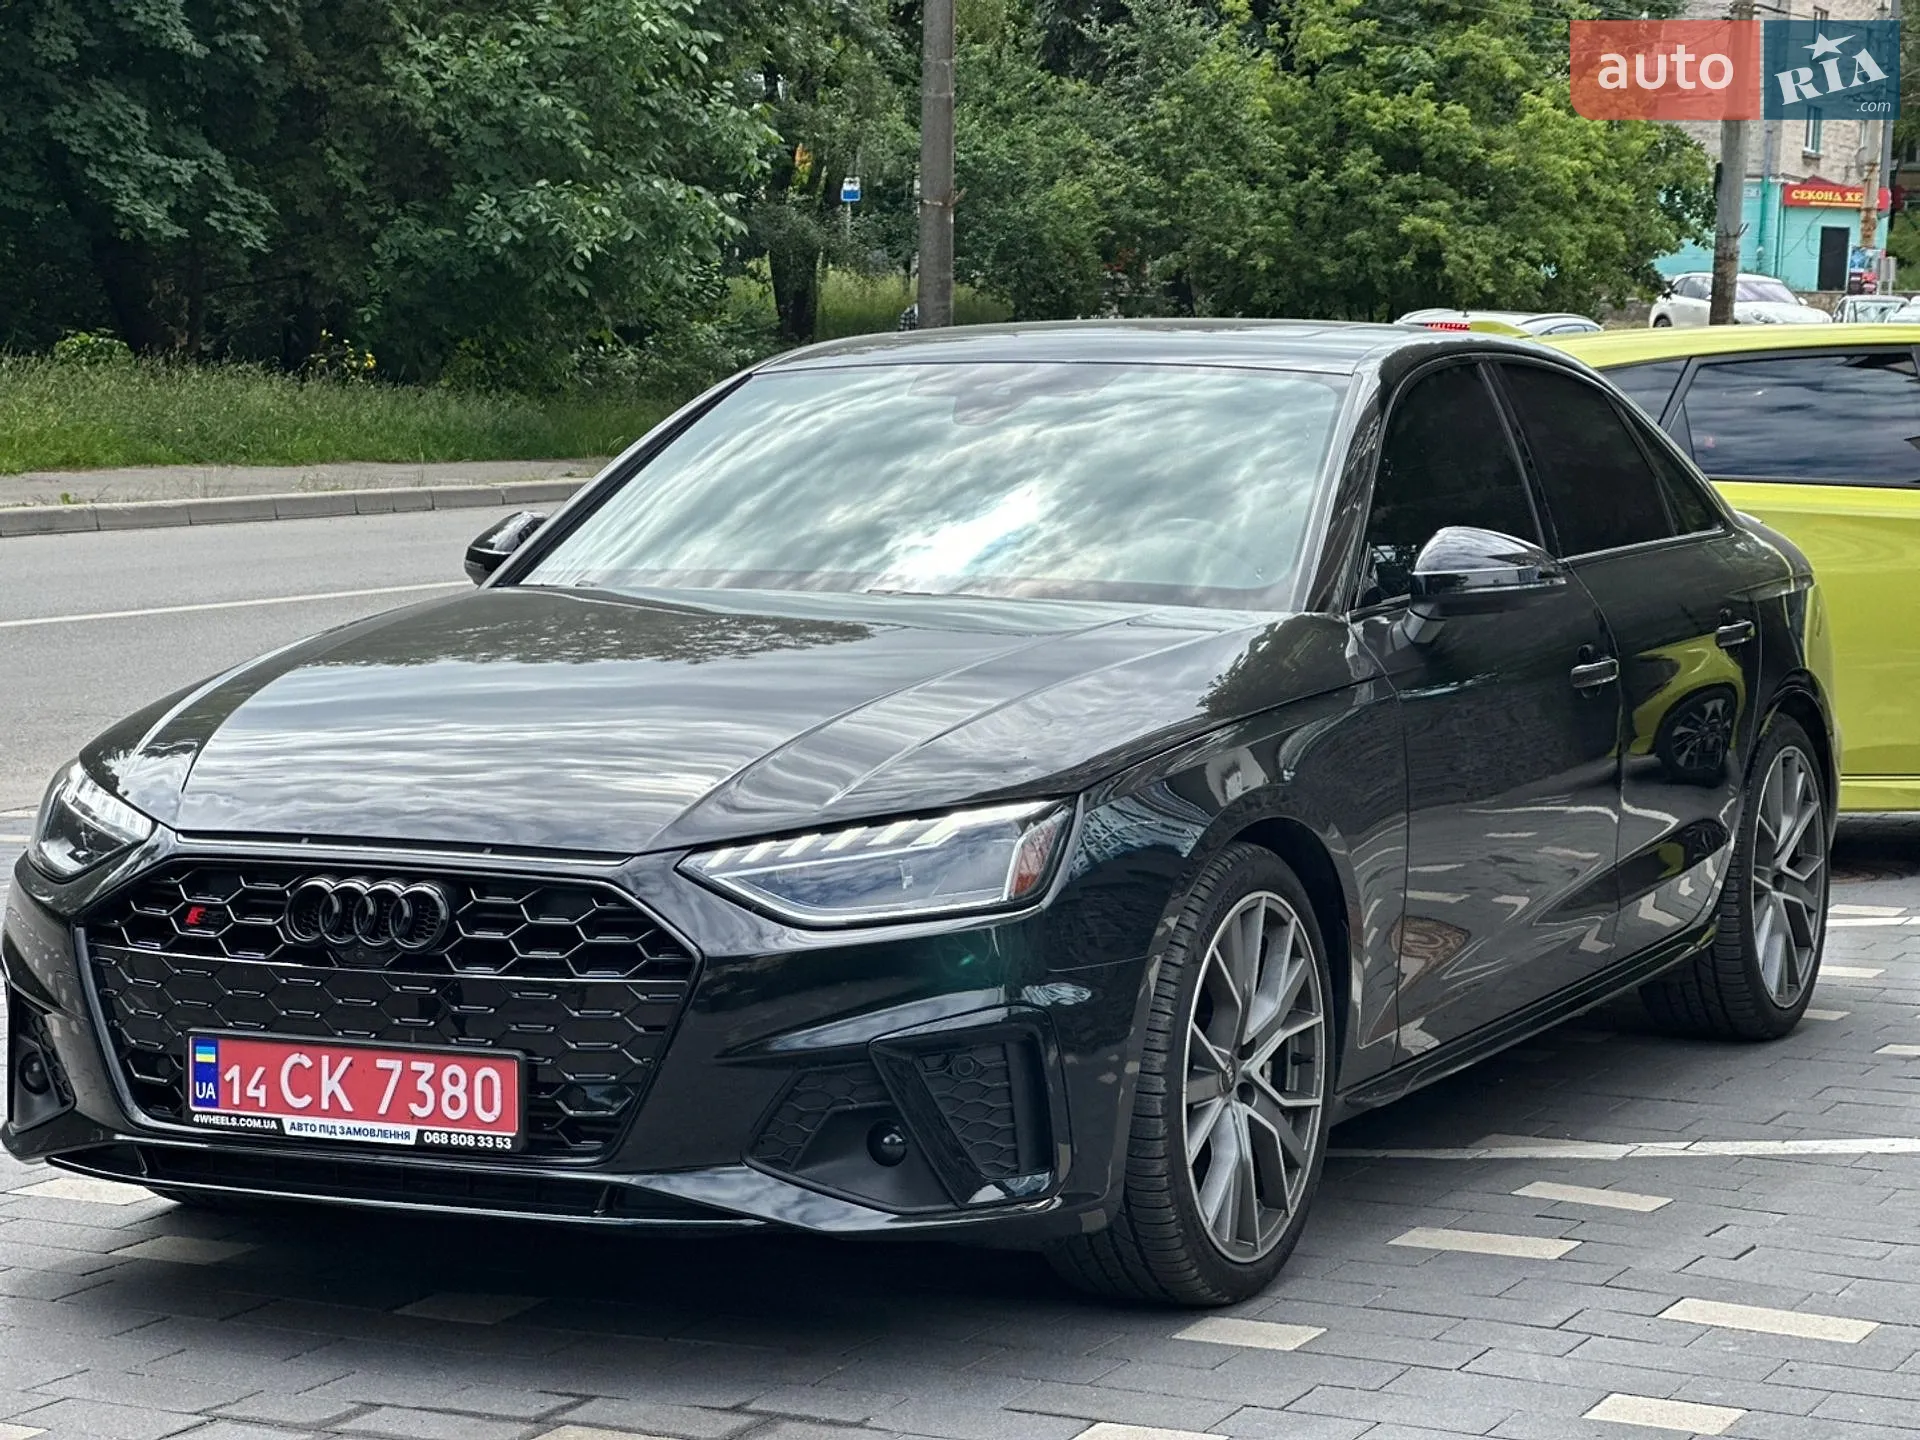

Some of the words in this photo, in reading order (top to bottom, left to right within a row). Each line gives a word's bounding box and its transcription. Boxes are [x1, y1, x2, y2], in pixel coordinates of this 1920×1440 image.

[1792, 190, 1842, 202] СЕКОНД
[195, 1081, 216, 1100] UA
[223, 1064, 267, 1108] 14
[280, 1053, 354, 1112] CK
[375, 1058, 501, 1123] 7380
[193, 1114, 277, 1130] 4WHEELS.COM.UA
[290, 1122, 317, 1133] АВТО
[319, 1124, 337, 1136] ПІД
[340, 1125, 410, 1140] ЗАМОВЛЕННЯ
[423, 1131, 448, 1144] 068
[450, 1133, 475, 1147] 808
[477, 1136, 493, 1148] 33
[496, 1137, 512, 1150] 53
